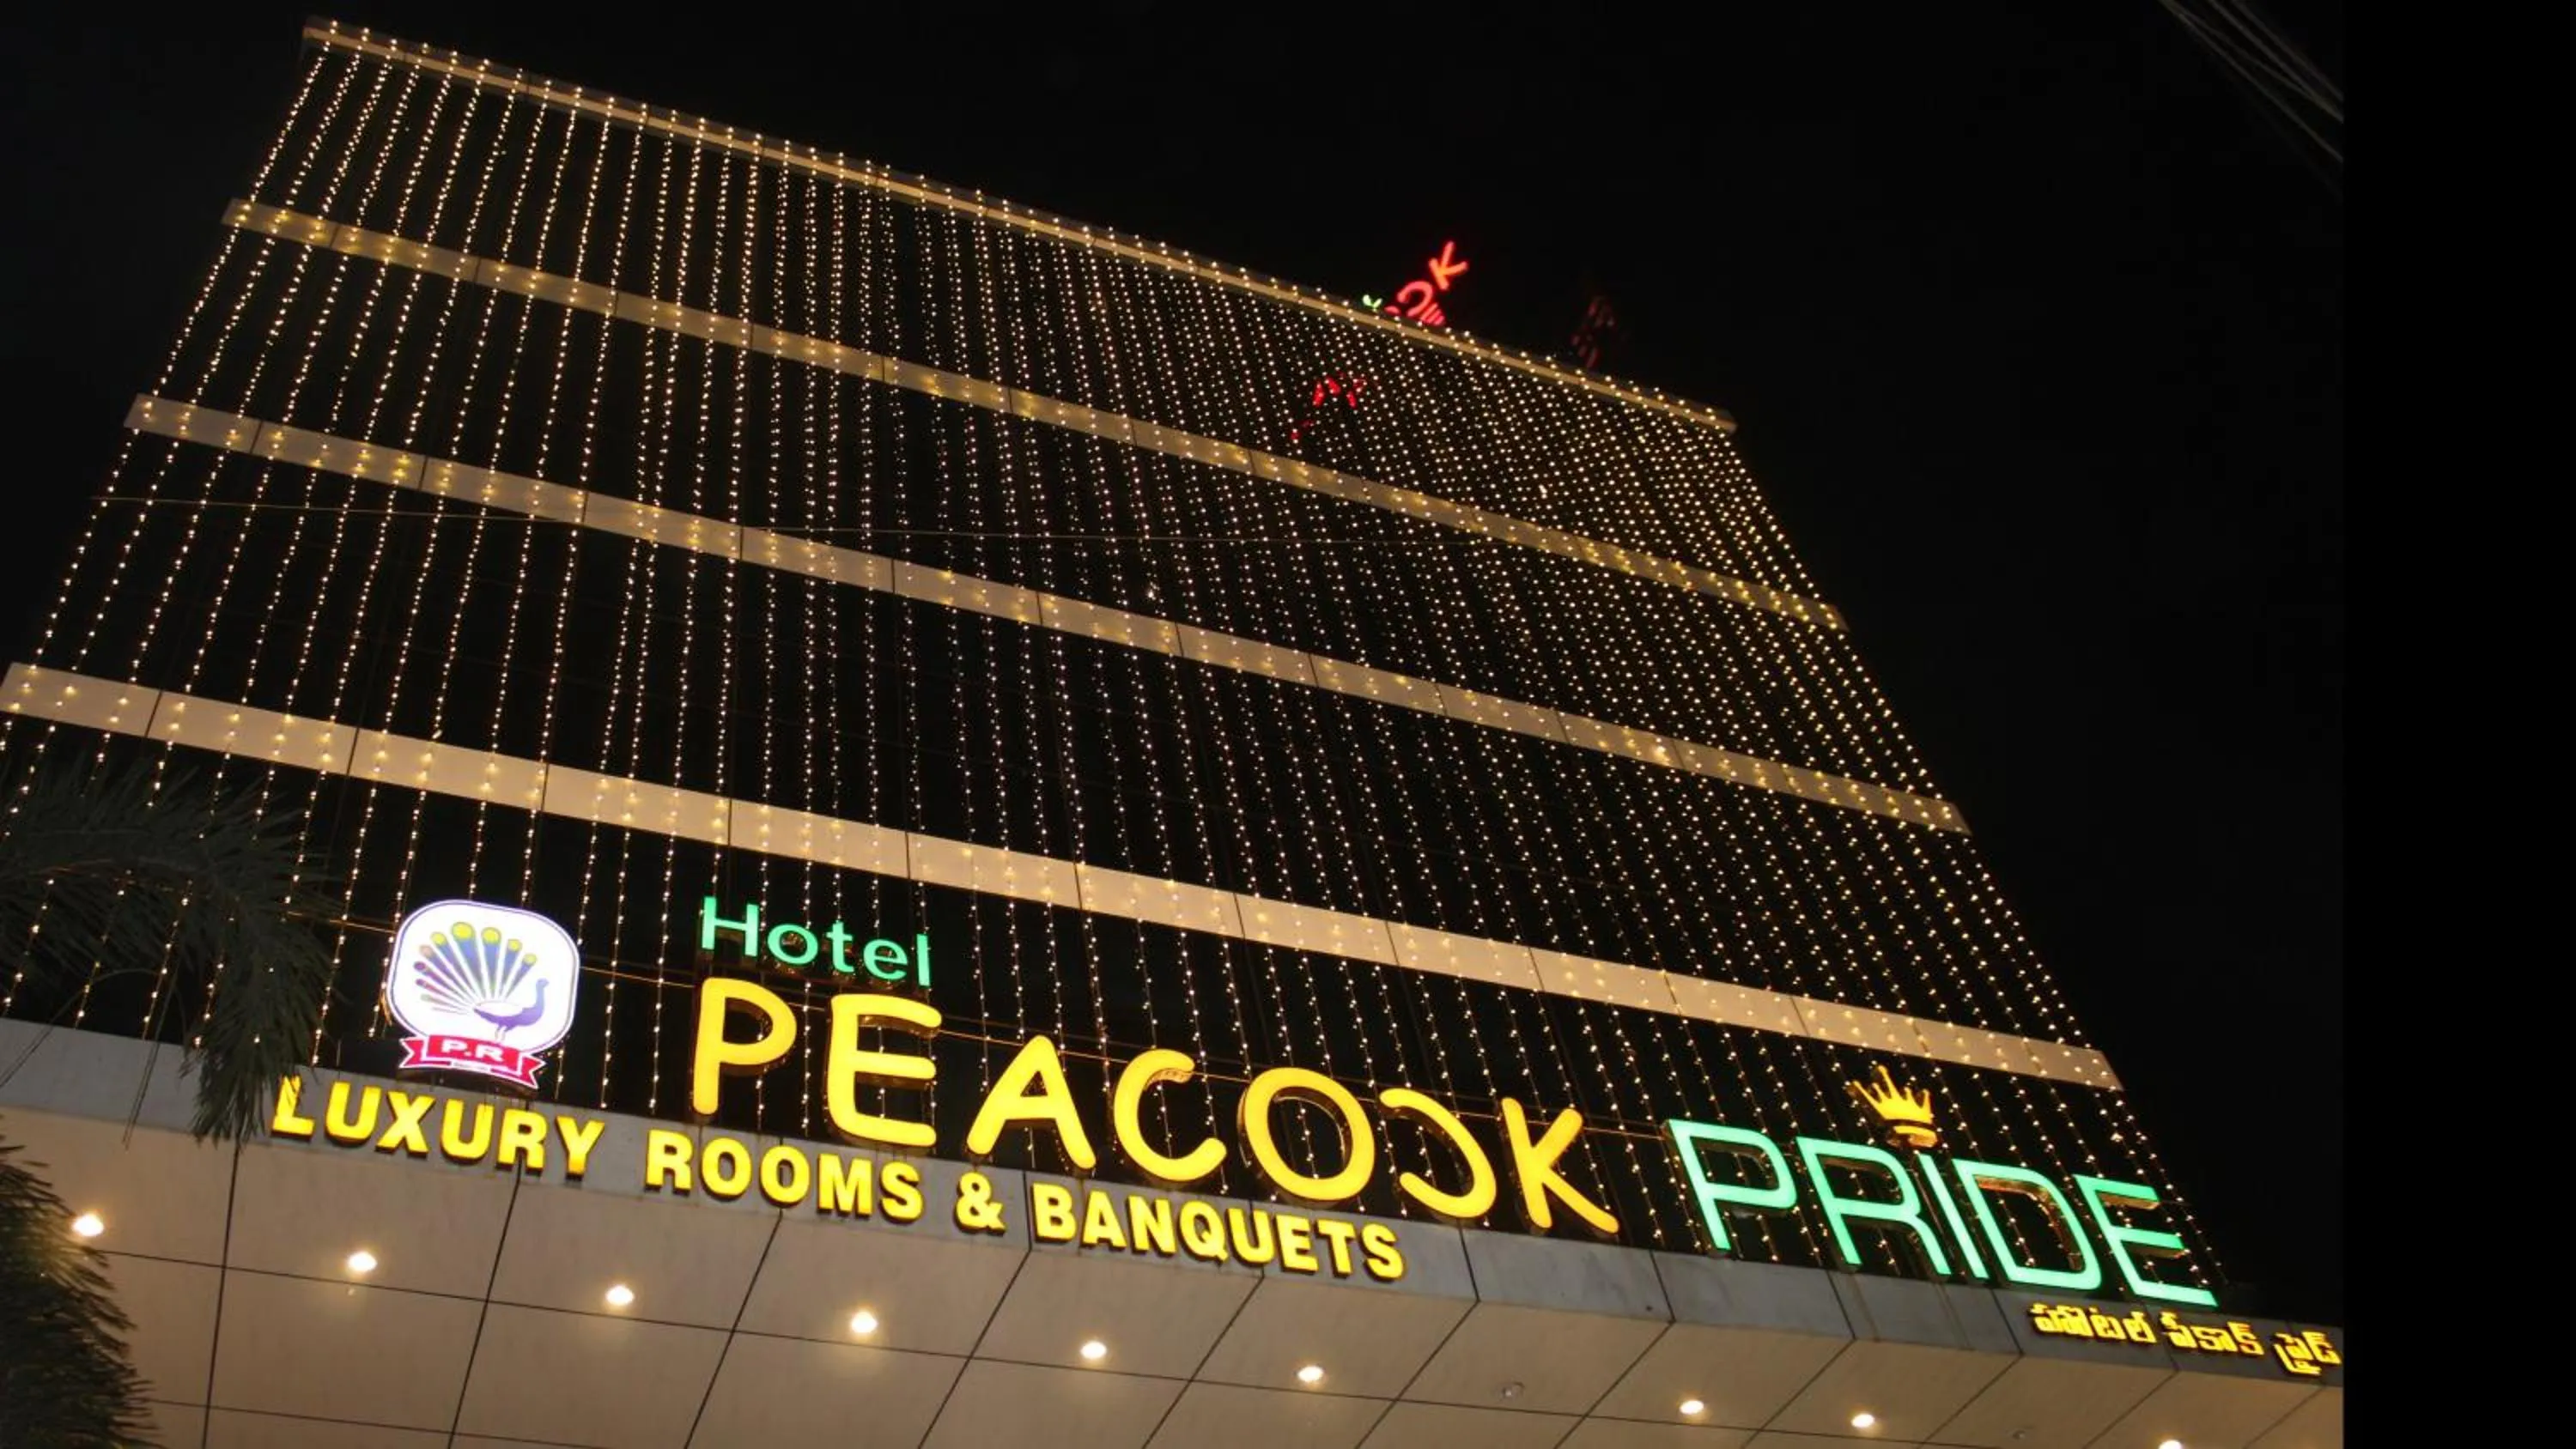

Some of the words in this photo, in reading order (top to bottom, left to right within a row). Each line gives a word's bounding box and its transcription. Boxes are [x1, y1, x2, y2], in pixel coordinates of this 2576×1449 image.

[701, 895, 933, 988] Hotel
[440, 1039, 505, 1063] P.R
[270, 1074, 606, 1176] LUXURY
[644, 1127, 925, 1221] ROOMS
[955, 1169, 1006, 1231] &
[1030, 1180, 1406, 1280] BANQUETS
[690, 975, 1620, 1234] PEACOCK
[1662, 1117, 2219, 1308] PRIDE
